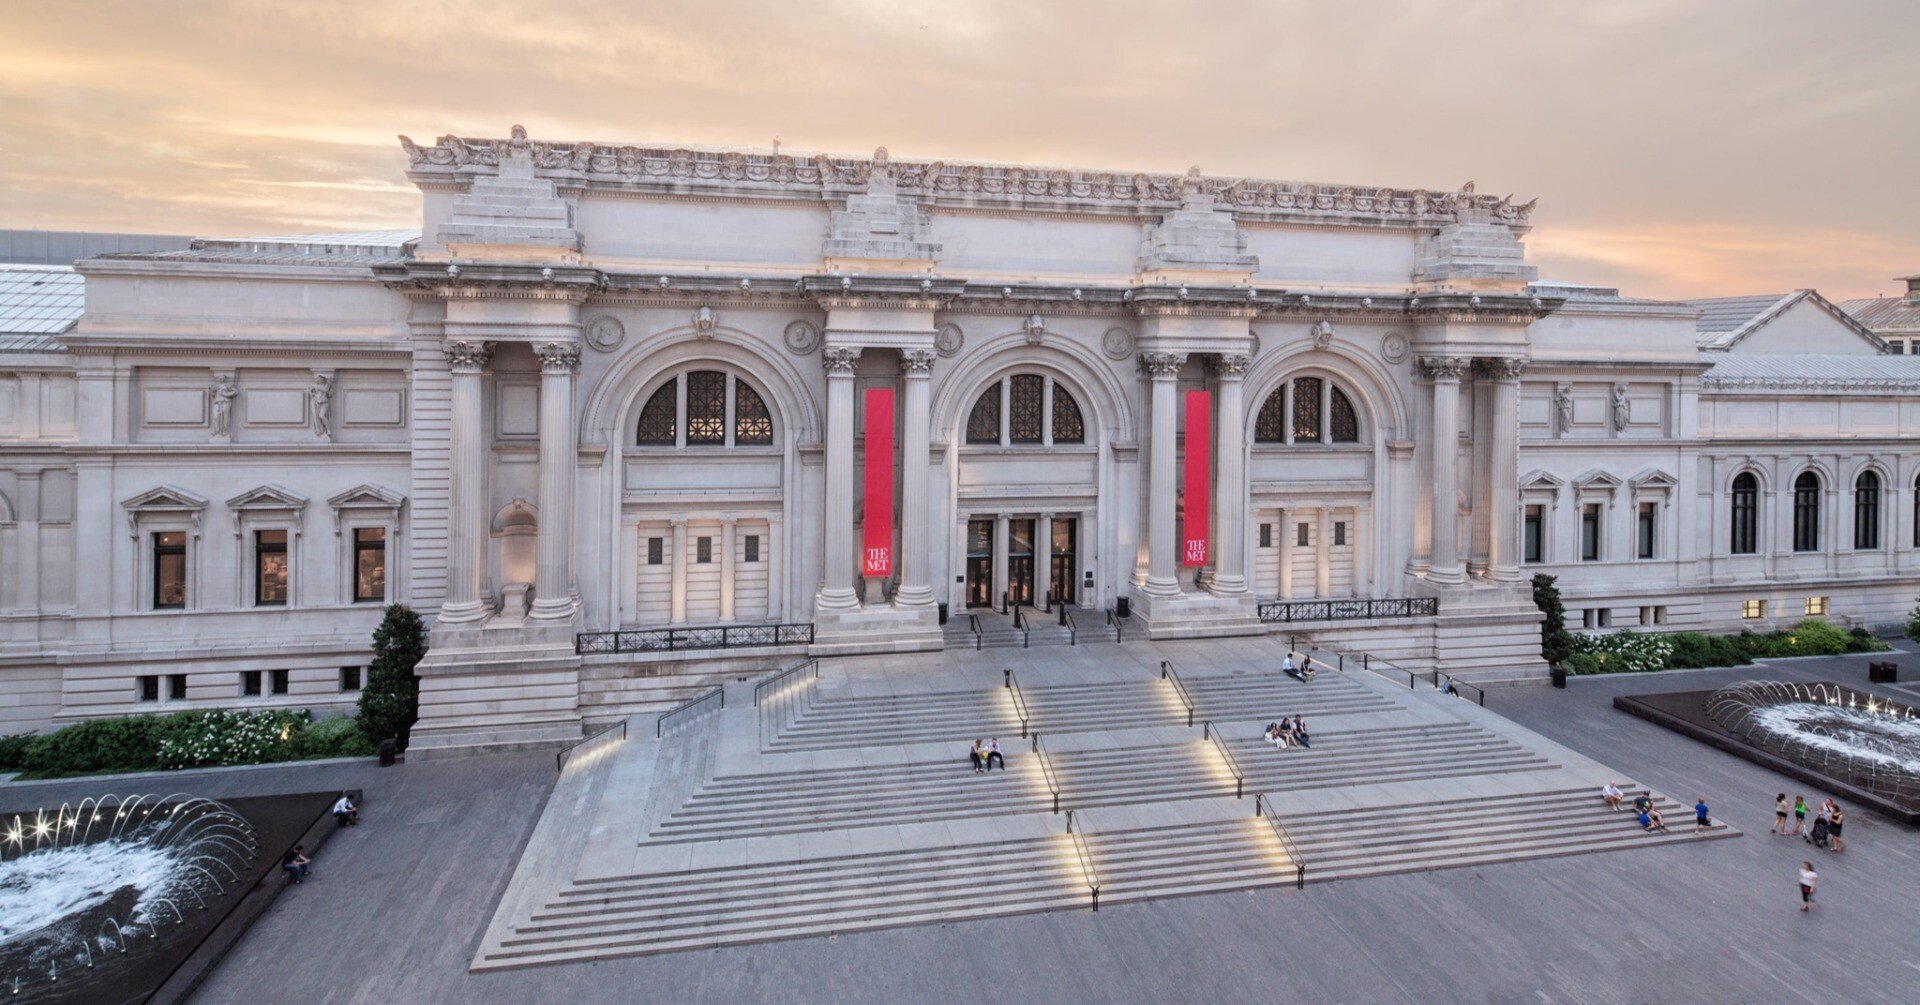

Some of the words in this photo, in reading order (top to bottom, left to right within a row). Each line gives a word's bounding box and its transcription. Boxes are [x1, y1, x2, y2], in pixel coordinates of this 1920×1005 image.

[1186, 540, 1206, 550] THE
[867, 548, 889, 560] THE
[1186, 550, 1206, 562] MET
[867, 560, 889, 571] MET
